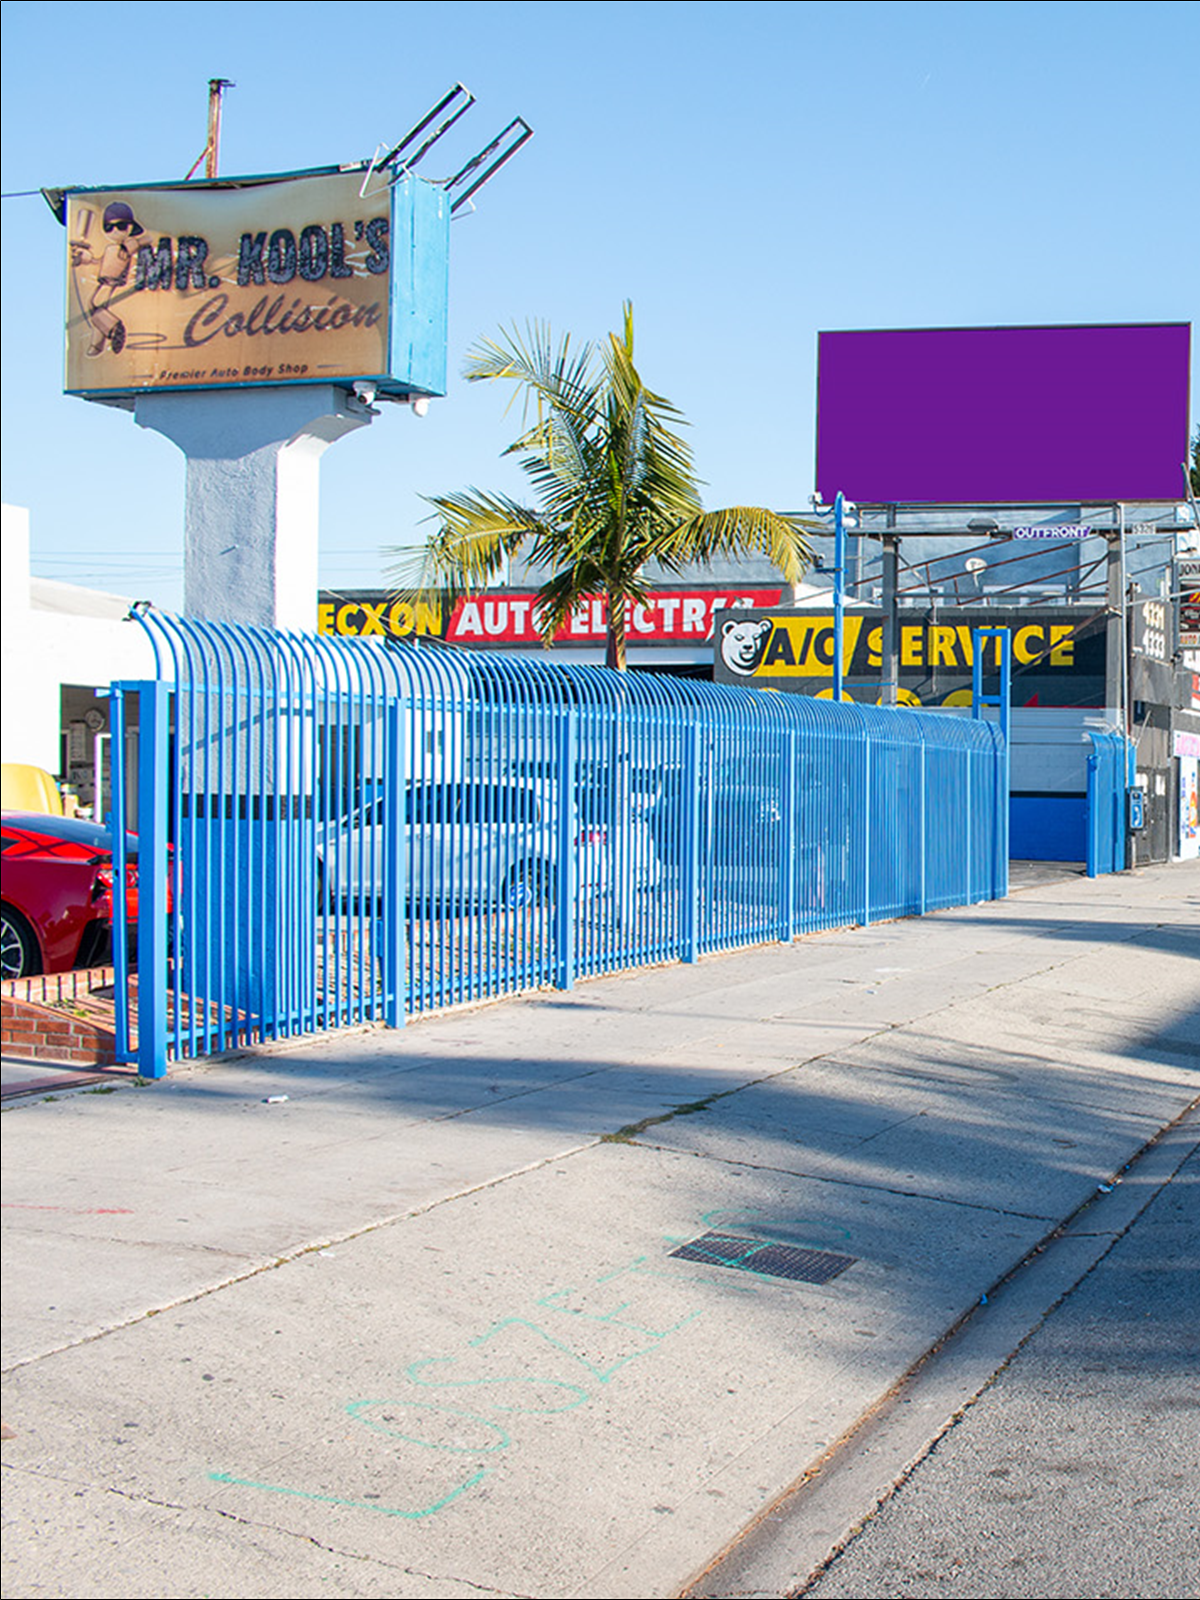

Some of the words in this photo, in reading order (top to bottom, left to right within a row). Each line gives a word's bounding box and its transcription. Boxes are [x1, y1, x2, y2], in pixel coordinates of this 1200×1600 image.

[135, 235, 220, 290] MR.
[236, 216, 390, 286] KOOL'S
[183, 293, 383, 348] Collision
[159, 369, 206, 380] Premier
[210, 367, 239, 377] Auto
[243, 364, 274, 377] Body
[278, 362, 309, 375] Shop
[866, 625, 1075, 667] SERVICE
